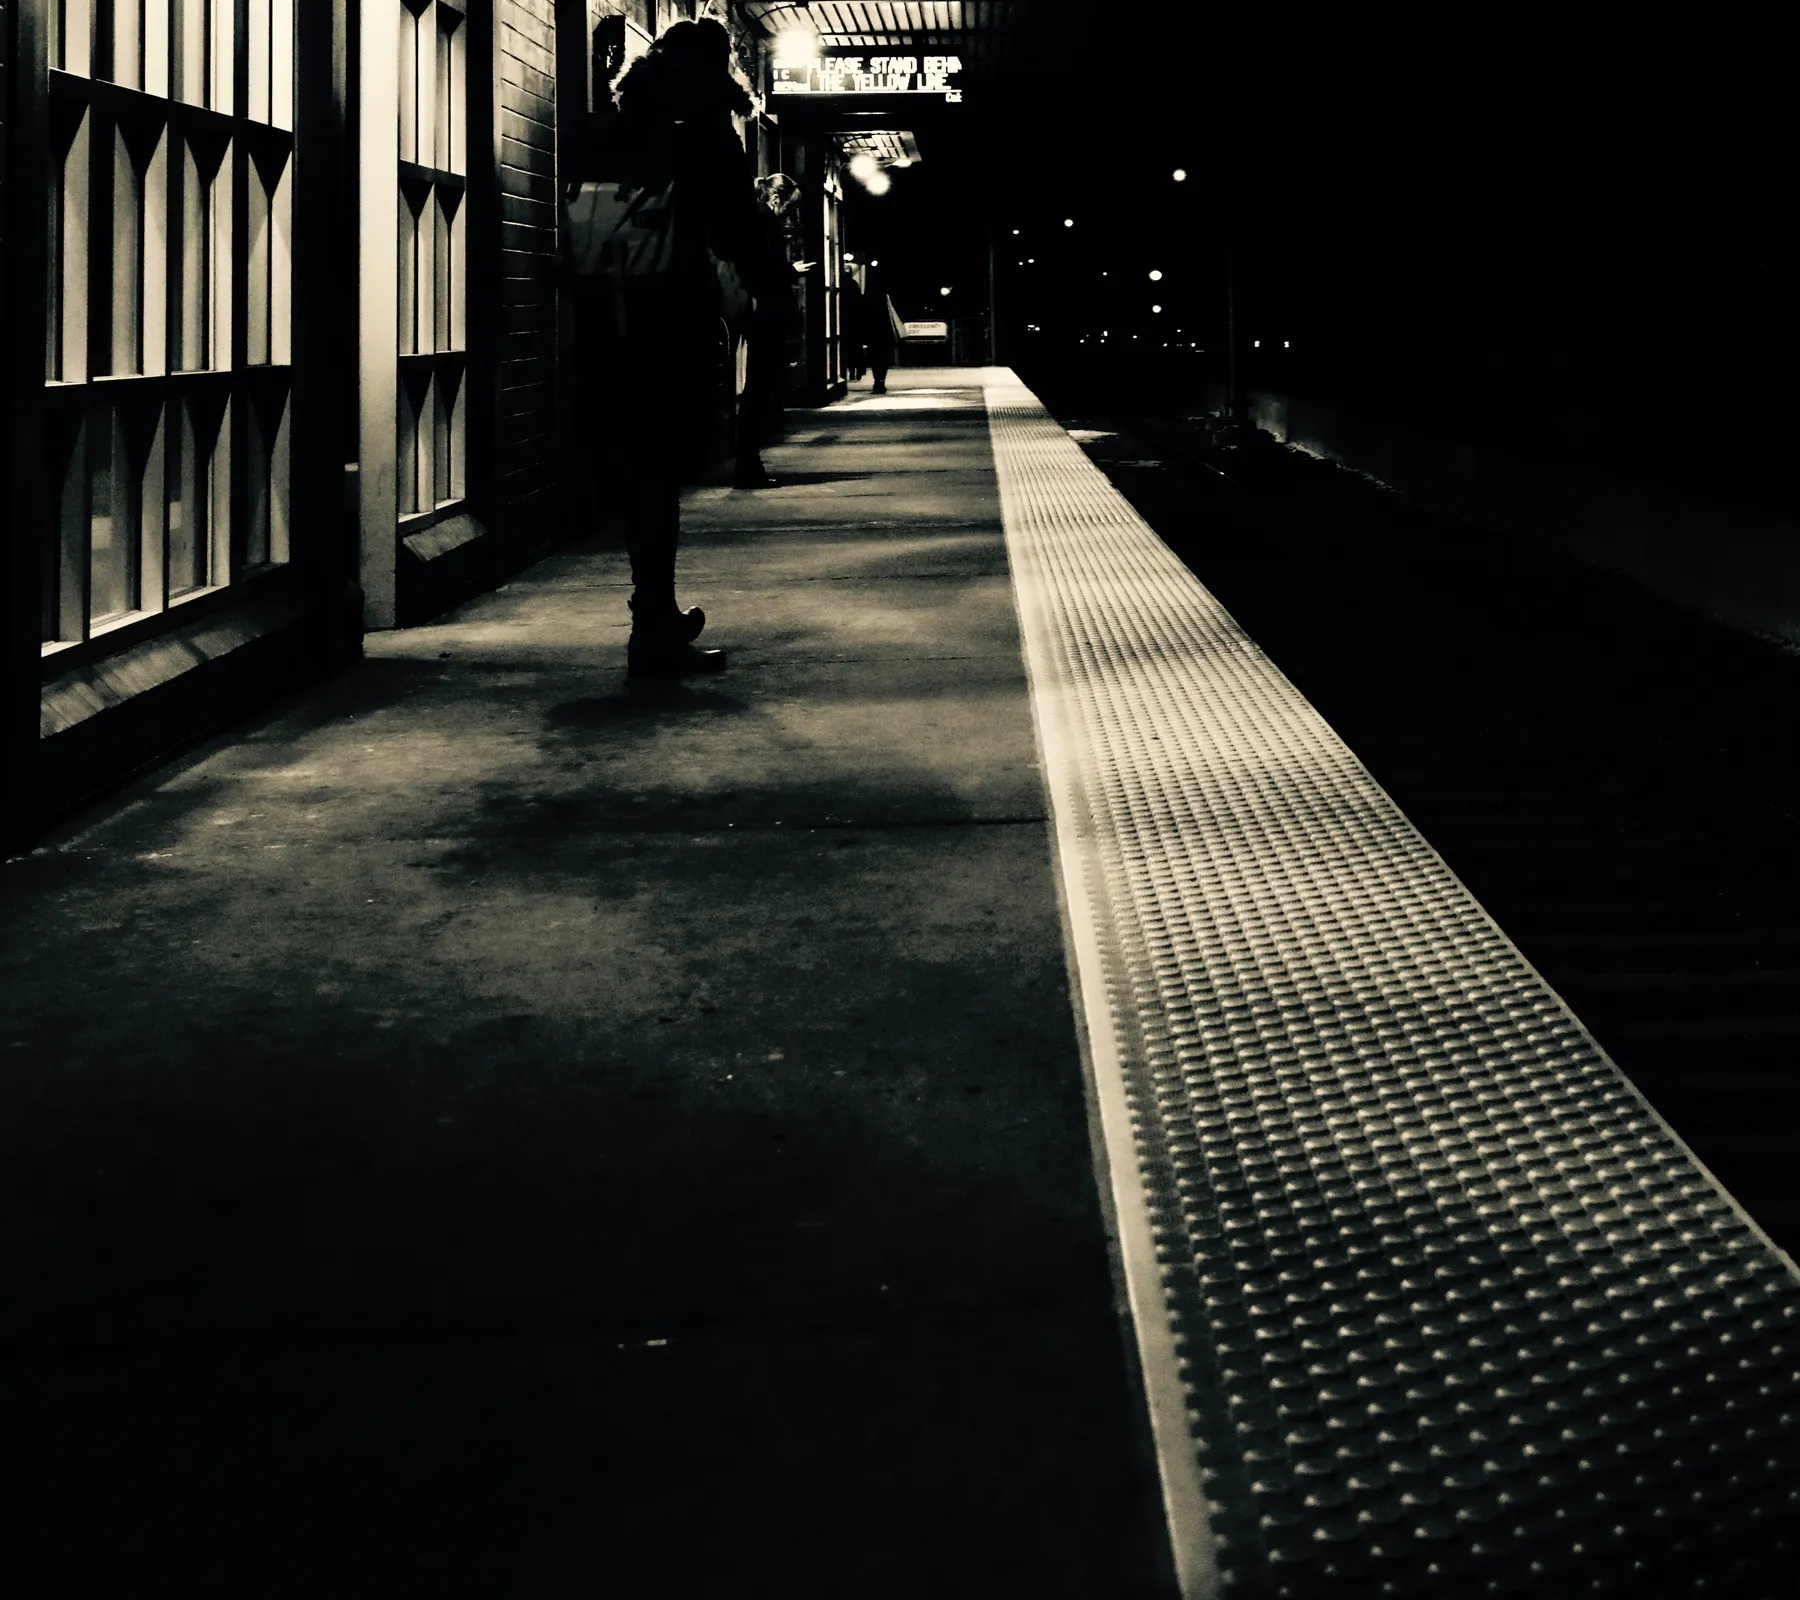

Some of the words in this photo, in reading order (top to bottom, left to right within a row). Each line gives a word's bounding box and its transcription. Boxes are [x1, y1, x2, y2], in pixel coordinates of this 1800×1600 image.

[810, 57, 863, 74] PLEASE
[870, 57, 917, 74] STAND
[816, 73, 844, 91] THE
[852, 73, 910, 91] YELLOW
[917, 73, 951, 91] LINE
